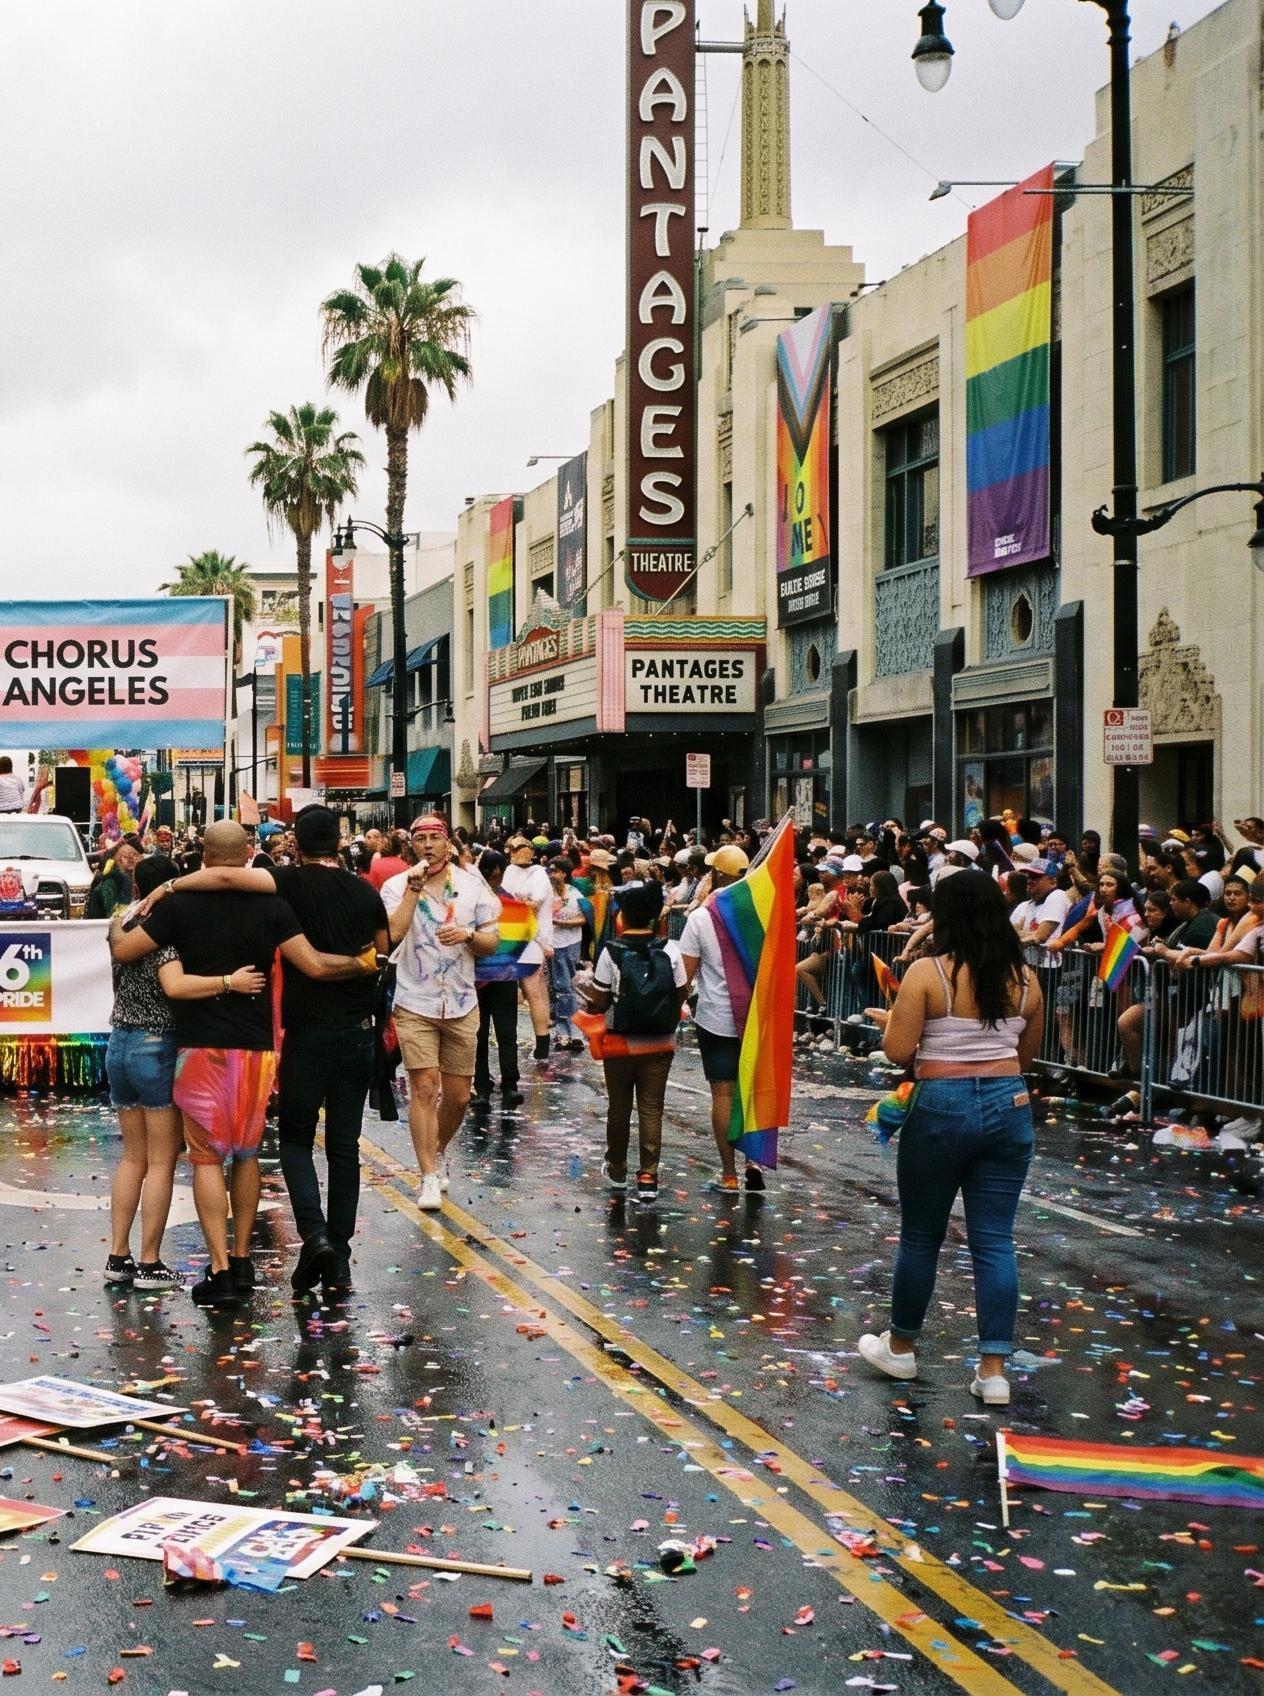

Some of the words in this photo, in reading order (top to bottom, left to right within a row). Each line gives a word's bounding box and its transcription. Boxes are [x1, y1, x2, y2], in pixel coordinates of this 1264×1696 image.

[638, 0, 687, 525] PANTAGES
[631, 552, 692, 573] THEATRE
[4, 638, 159, 669] CHORUS
[631, 658, 744, 679] PANTAGES
[2, 675, 170, 707] ANGELES
[640, 684, 737, 704] THEATRE
